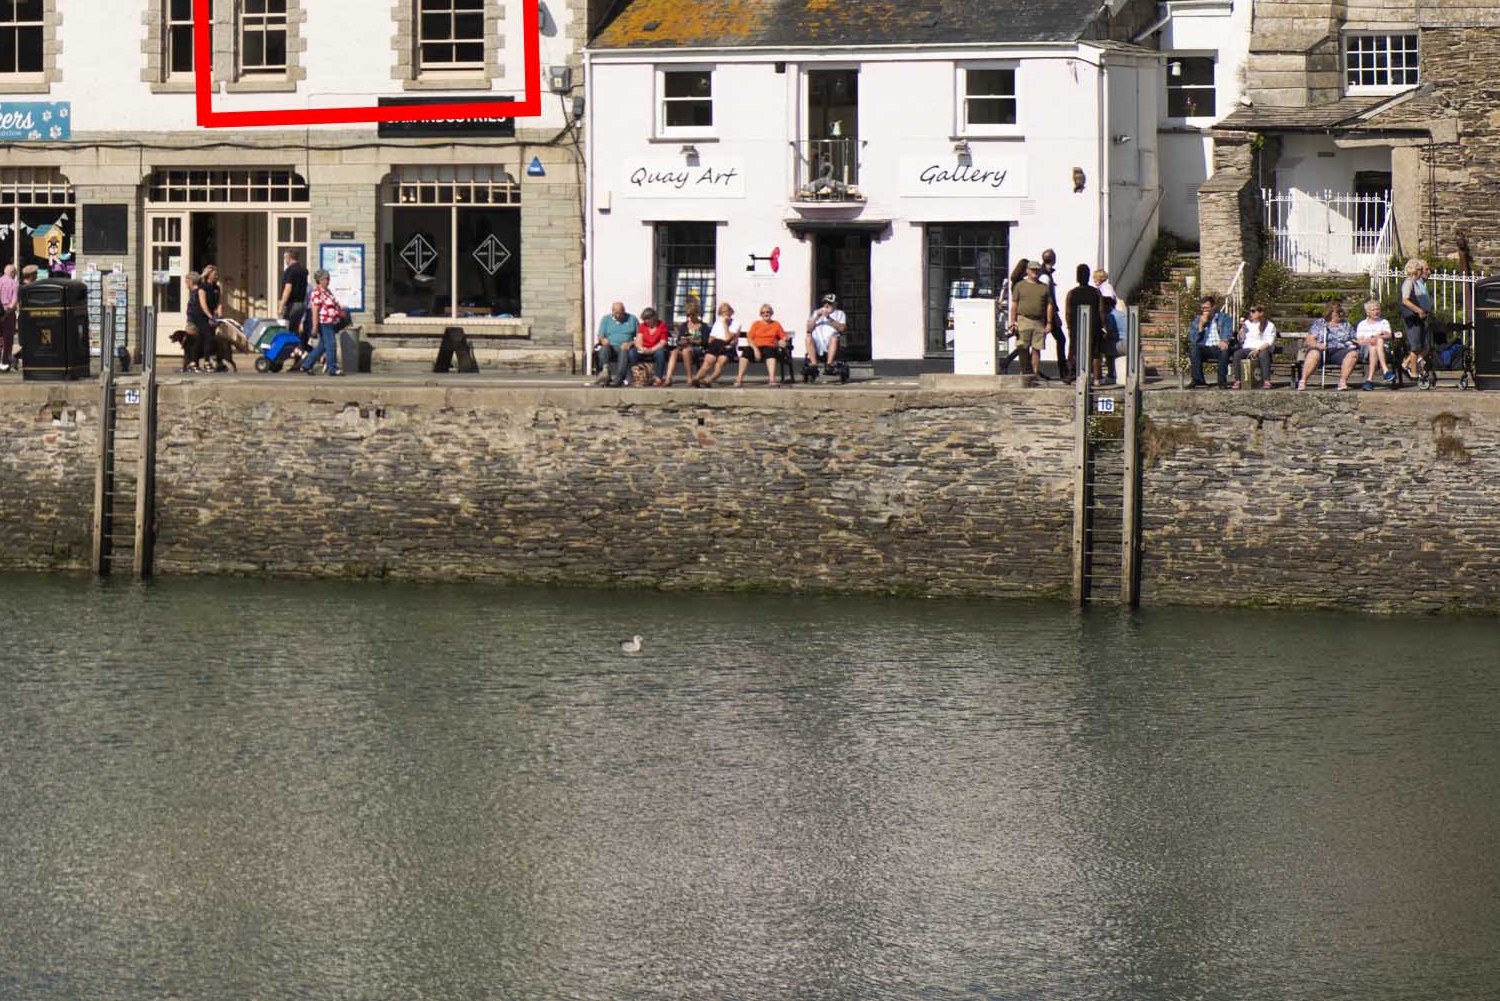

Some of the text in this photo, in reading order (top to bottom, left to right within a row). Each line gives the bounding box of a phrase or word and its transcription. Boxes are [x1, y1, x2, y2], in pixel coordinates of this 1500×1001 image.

[630, 166, 739, 189] Quay Art
[919, 164, 1008, 188] Gallery
[126, 390, 138, 402] 15
[1101, 399, 1113, 410] 16
